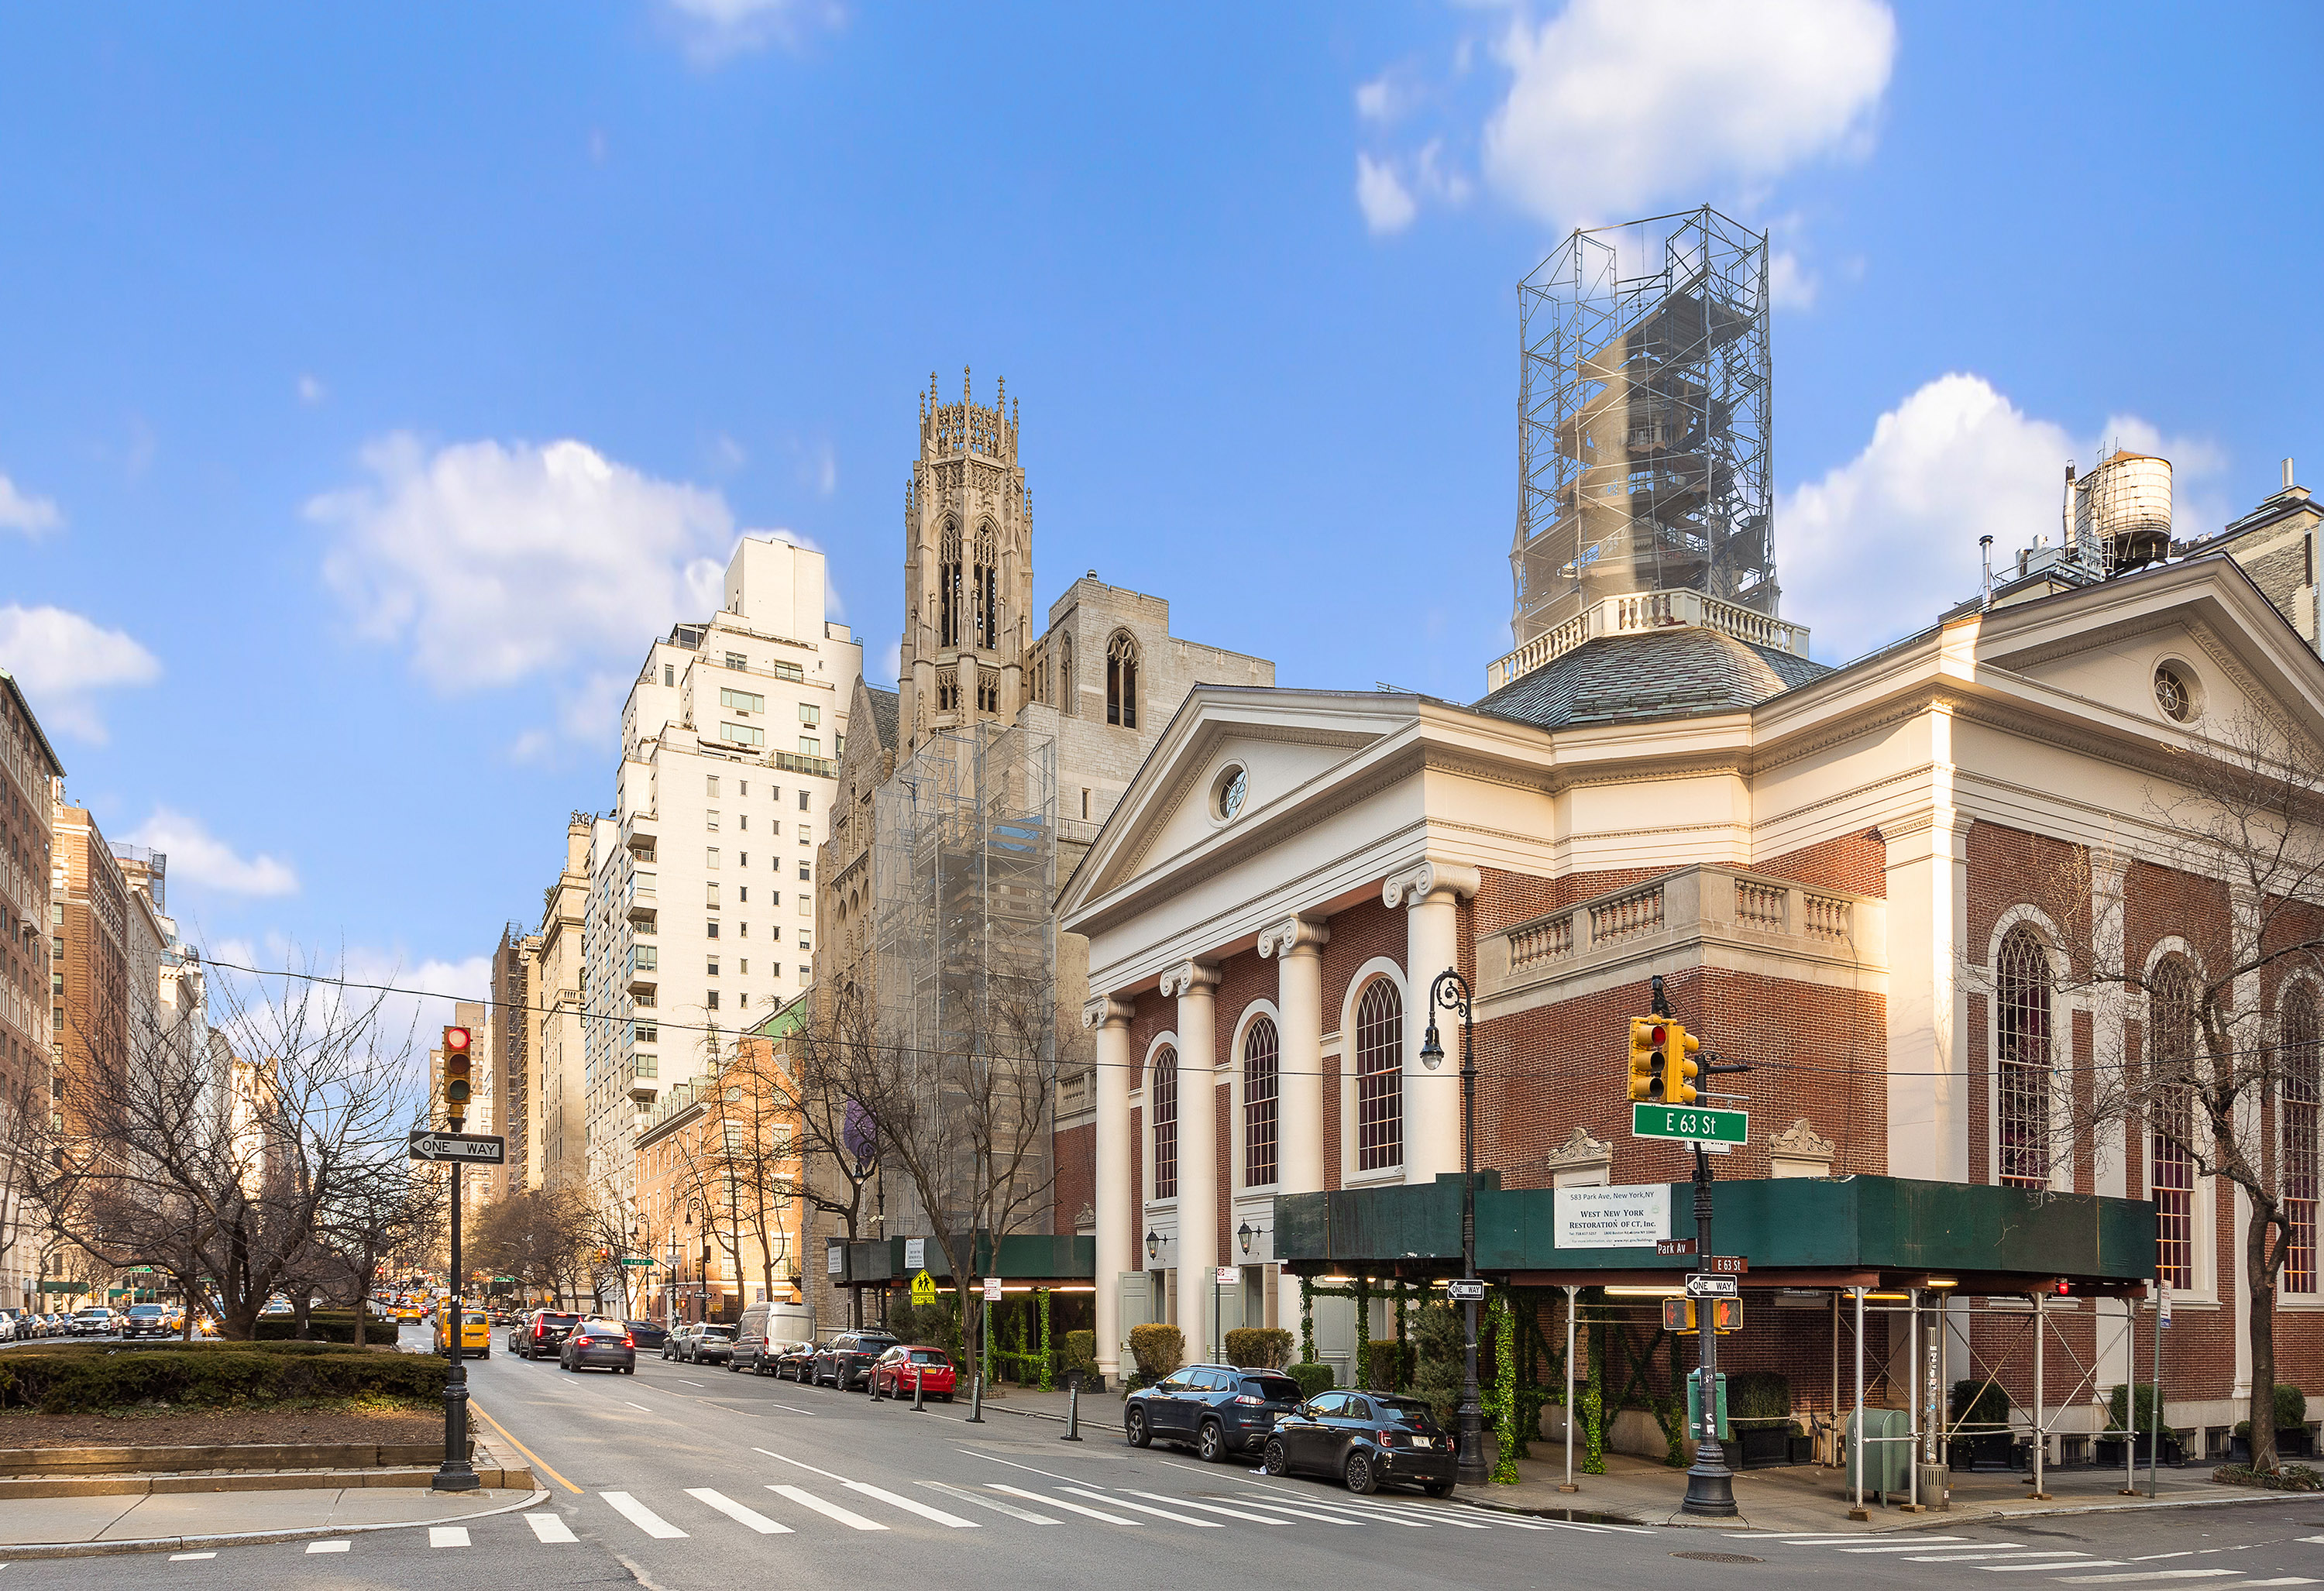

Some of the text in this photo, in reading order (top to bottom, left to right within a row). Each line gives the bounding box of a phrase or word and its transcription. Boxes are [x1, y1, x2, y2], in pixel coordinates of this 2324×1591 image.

[1666, 1112, 1717, 1135] E 63 St
[422, 1140, 496, 1155] ONE WAY
[1658, 1242, 1686, 1254] Park Av
[1717, 1259, 1741, 1271] E 63 St
[1693, 1281, 1732, 1290] ONE WAY
